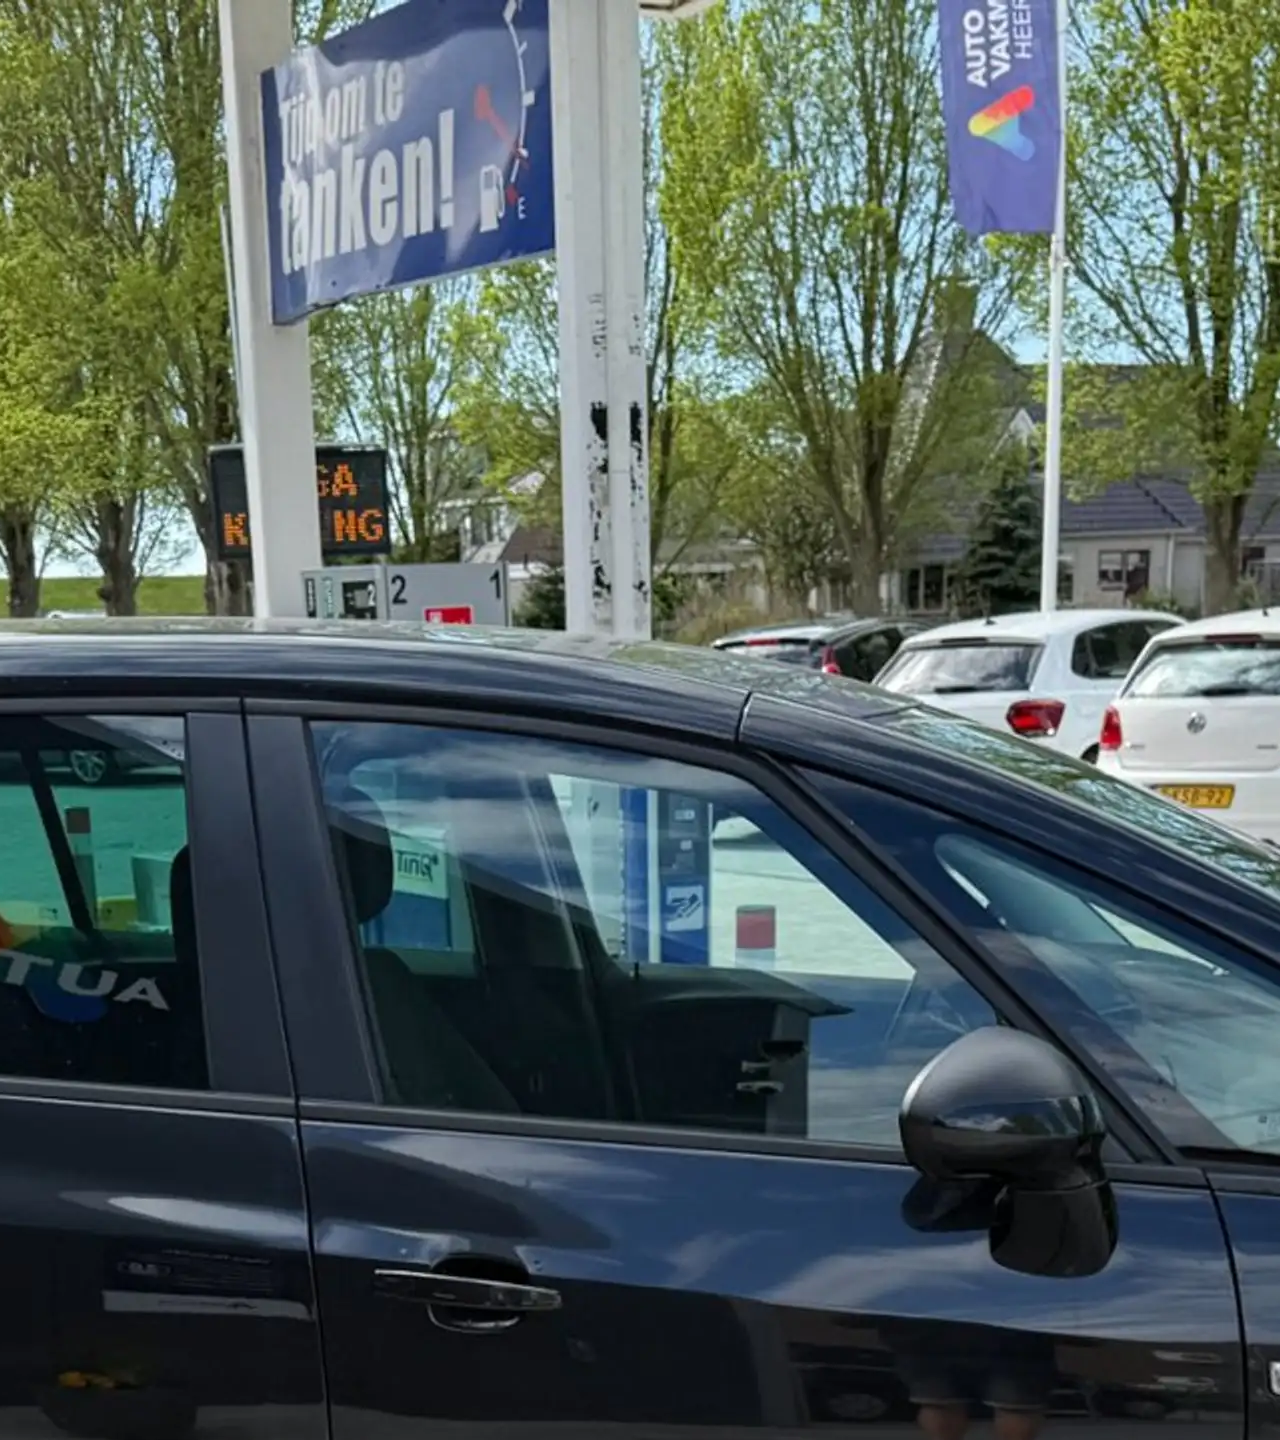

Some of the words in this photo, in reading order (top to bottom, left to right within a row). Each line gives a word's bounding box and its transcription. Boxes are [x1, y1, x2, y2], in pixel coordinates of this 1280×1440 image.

[963, 9, 988, 88] AUTO
[325, 75, 368, 149] om
[374, 59, 404, 126] te
[280, 108, 455, 275] tanken!
[518, 196, 526, 220] E
[391, 574, 408, 605] 2
[489, 569, 502, 600] 1
